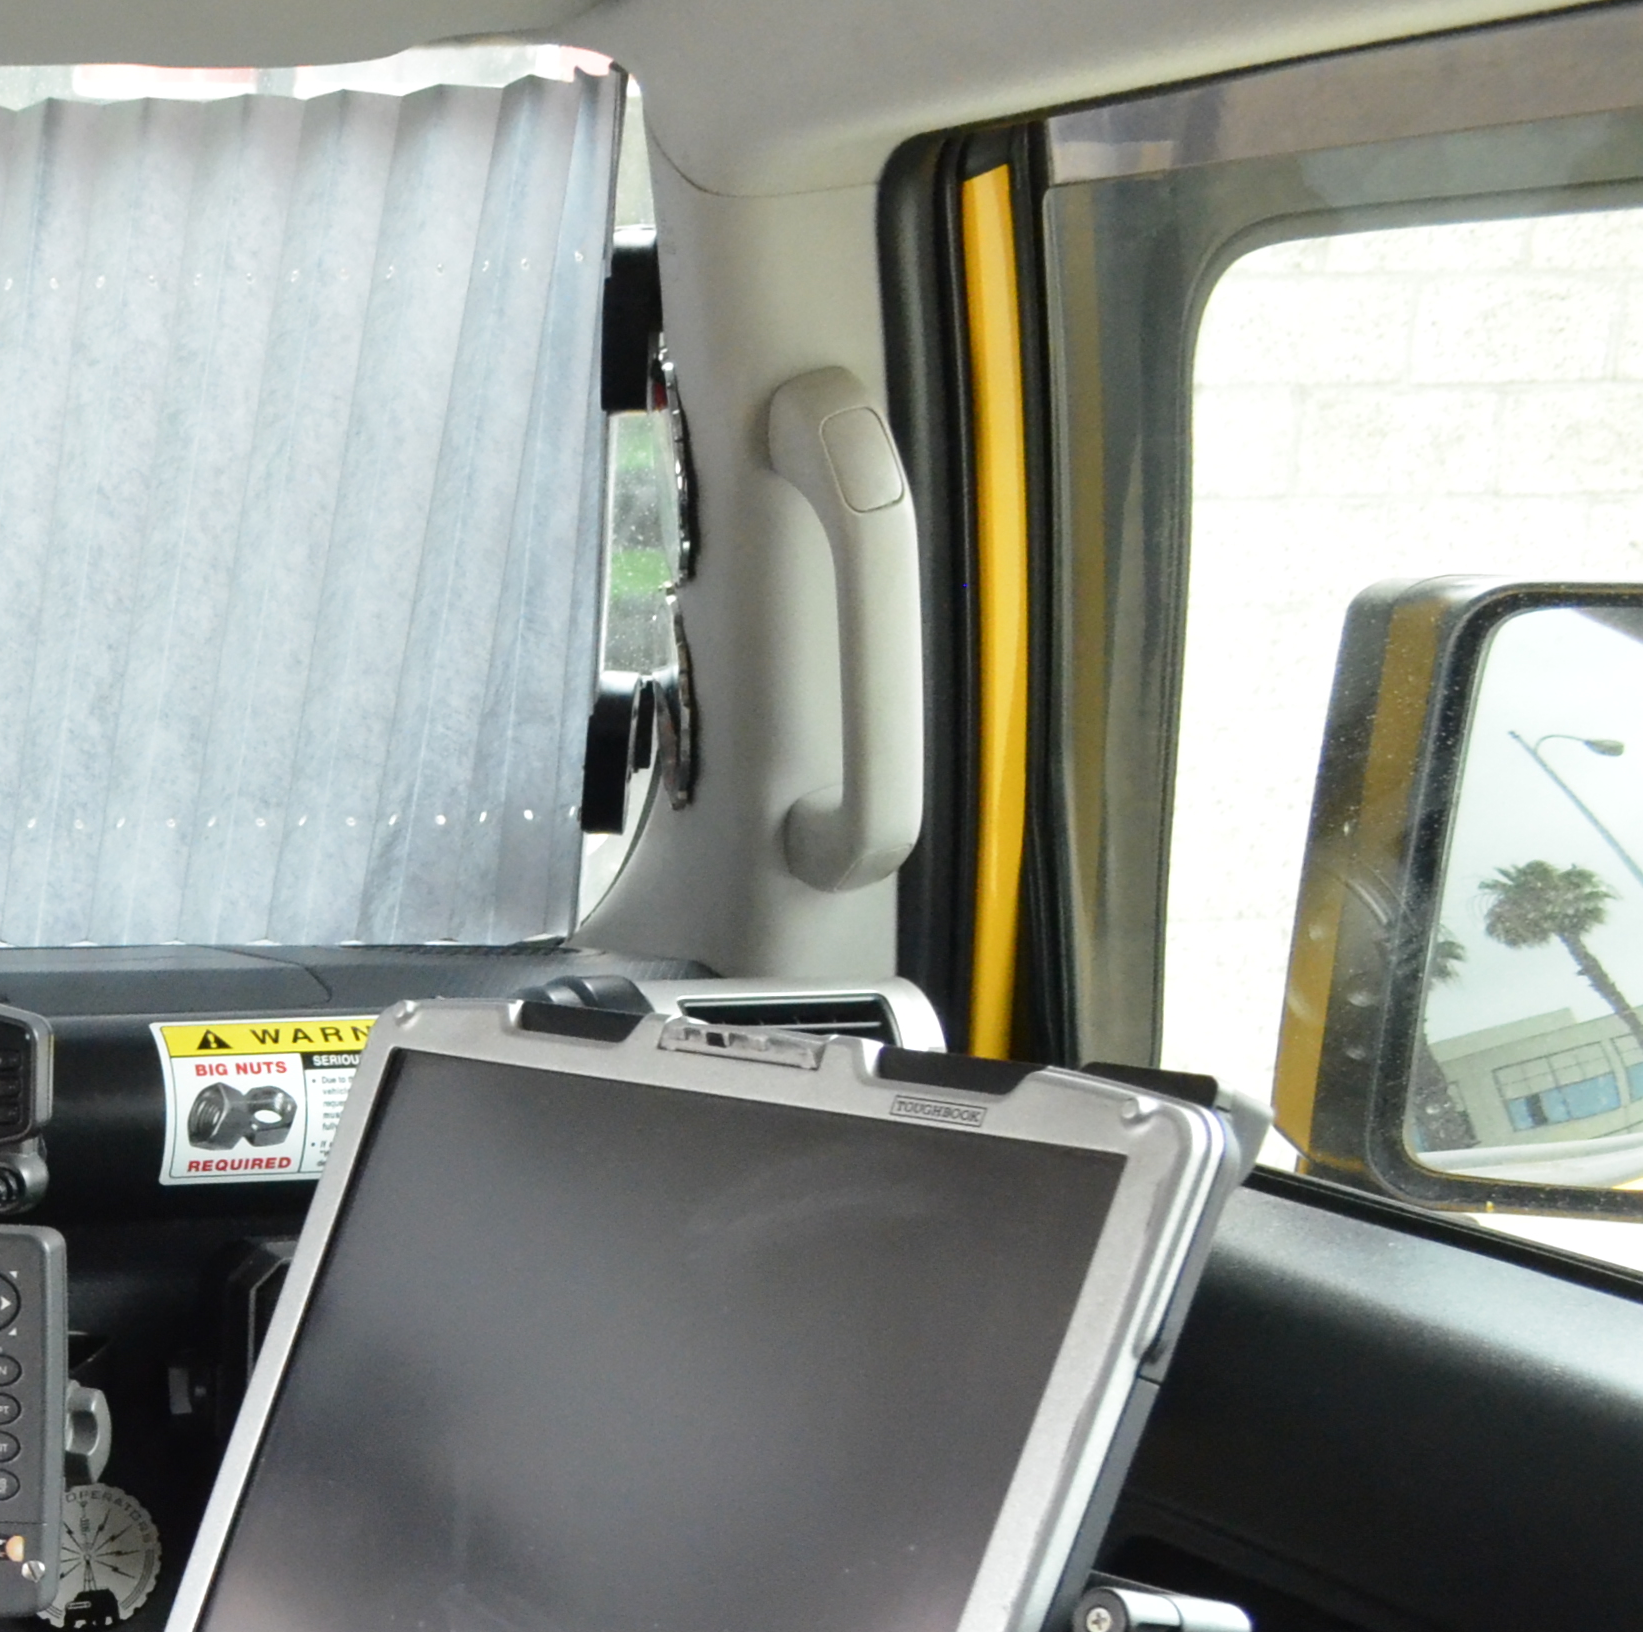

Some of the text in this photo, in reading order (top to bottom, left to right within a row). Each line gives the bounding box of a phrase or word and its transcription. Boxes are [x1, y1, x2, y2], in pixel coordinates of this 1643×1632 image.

[195, 1061, 288, 1077] BIG NUTS
[321, 1076, 337, 1084] Due
[896, 1100, 981, 1123] TOUGHBOOK
[187, 1157, 292, 1172] REQUIRED
